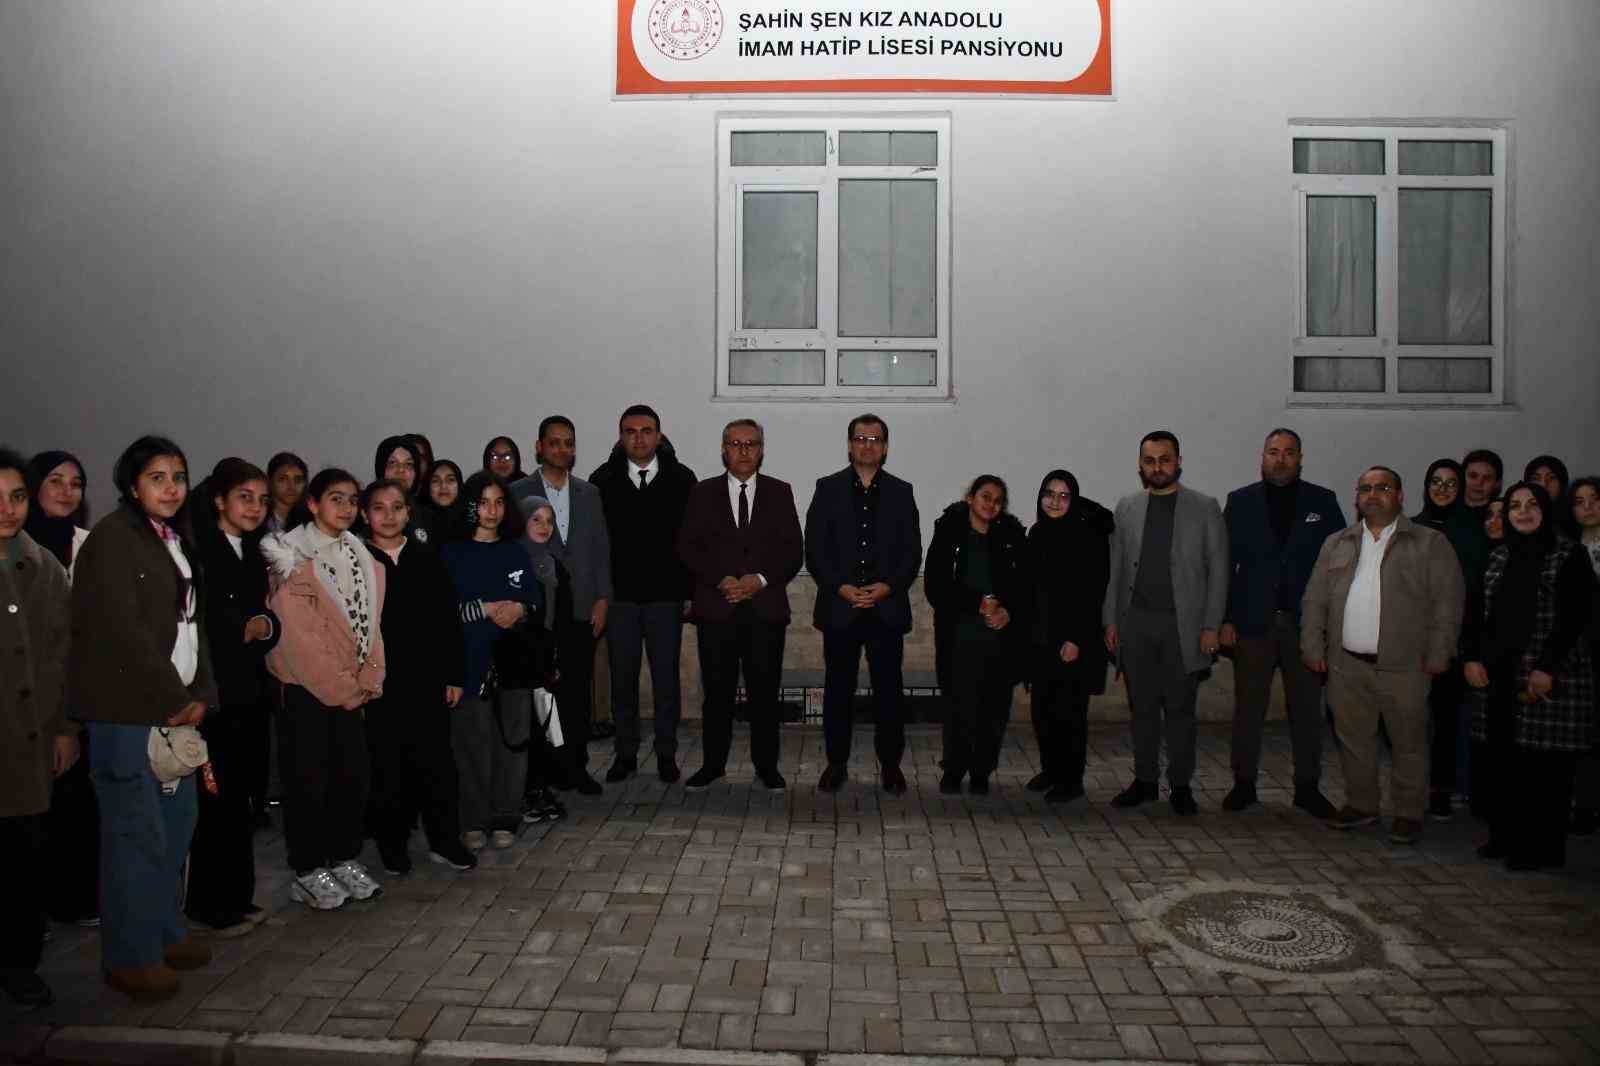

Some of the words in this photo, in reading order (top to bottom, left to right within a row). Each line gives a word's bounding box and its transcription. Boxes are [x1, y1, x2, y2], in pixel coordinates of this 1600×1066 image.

[738, 9, 803, 33] ŞAHİN
[809, 12, 852, 31] ŞEN
[859, 11, 894, 28] KIZ
[898, 11, 1004, 29] ANADOLU
[738, 37, 793, 57] İMAM
[800, 36, 861, 56] HATİP
[867, 36, 934, 56] LİSESİ
[941, 37, 1063, 58] PANSİYONU
